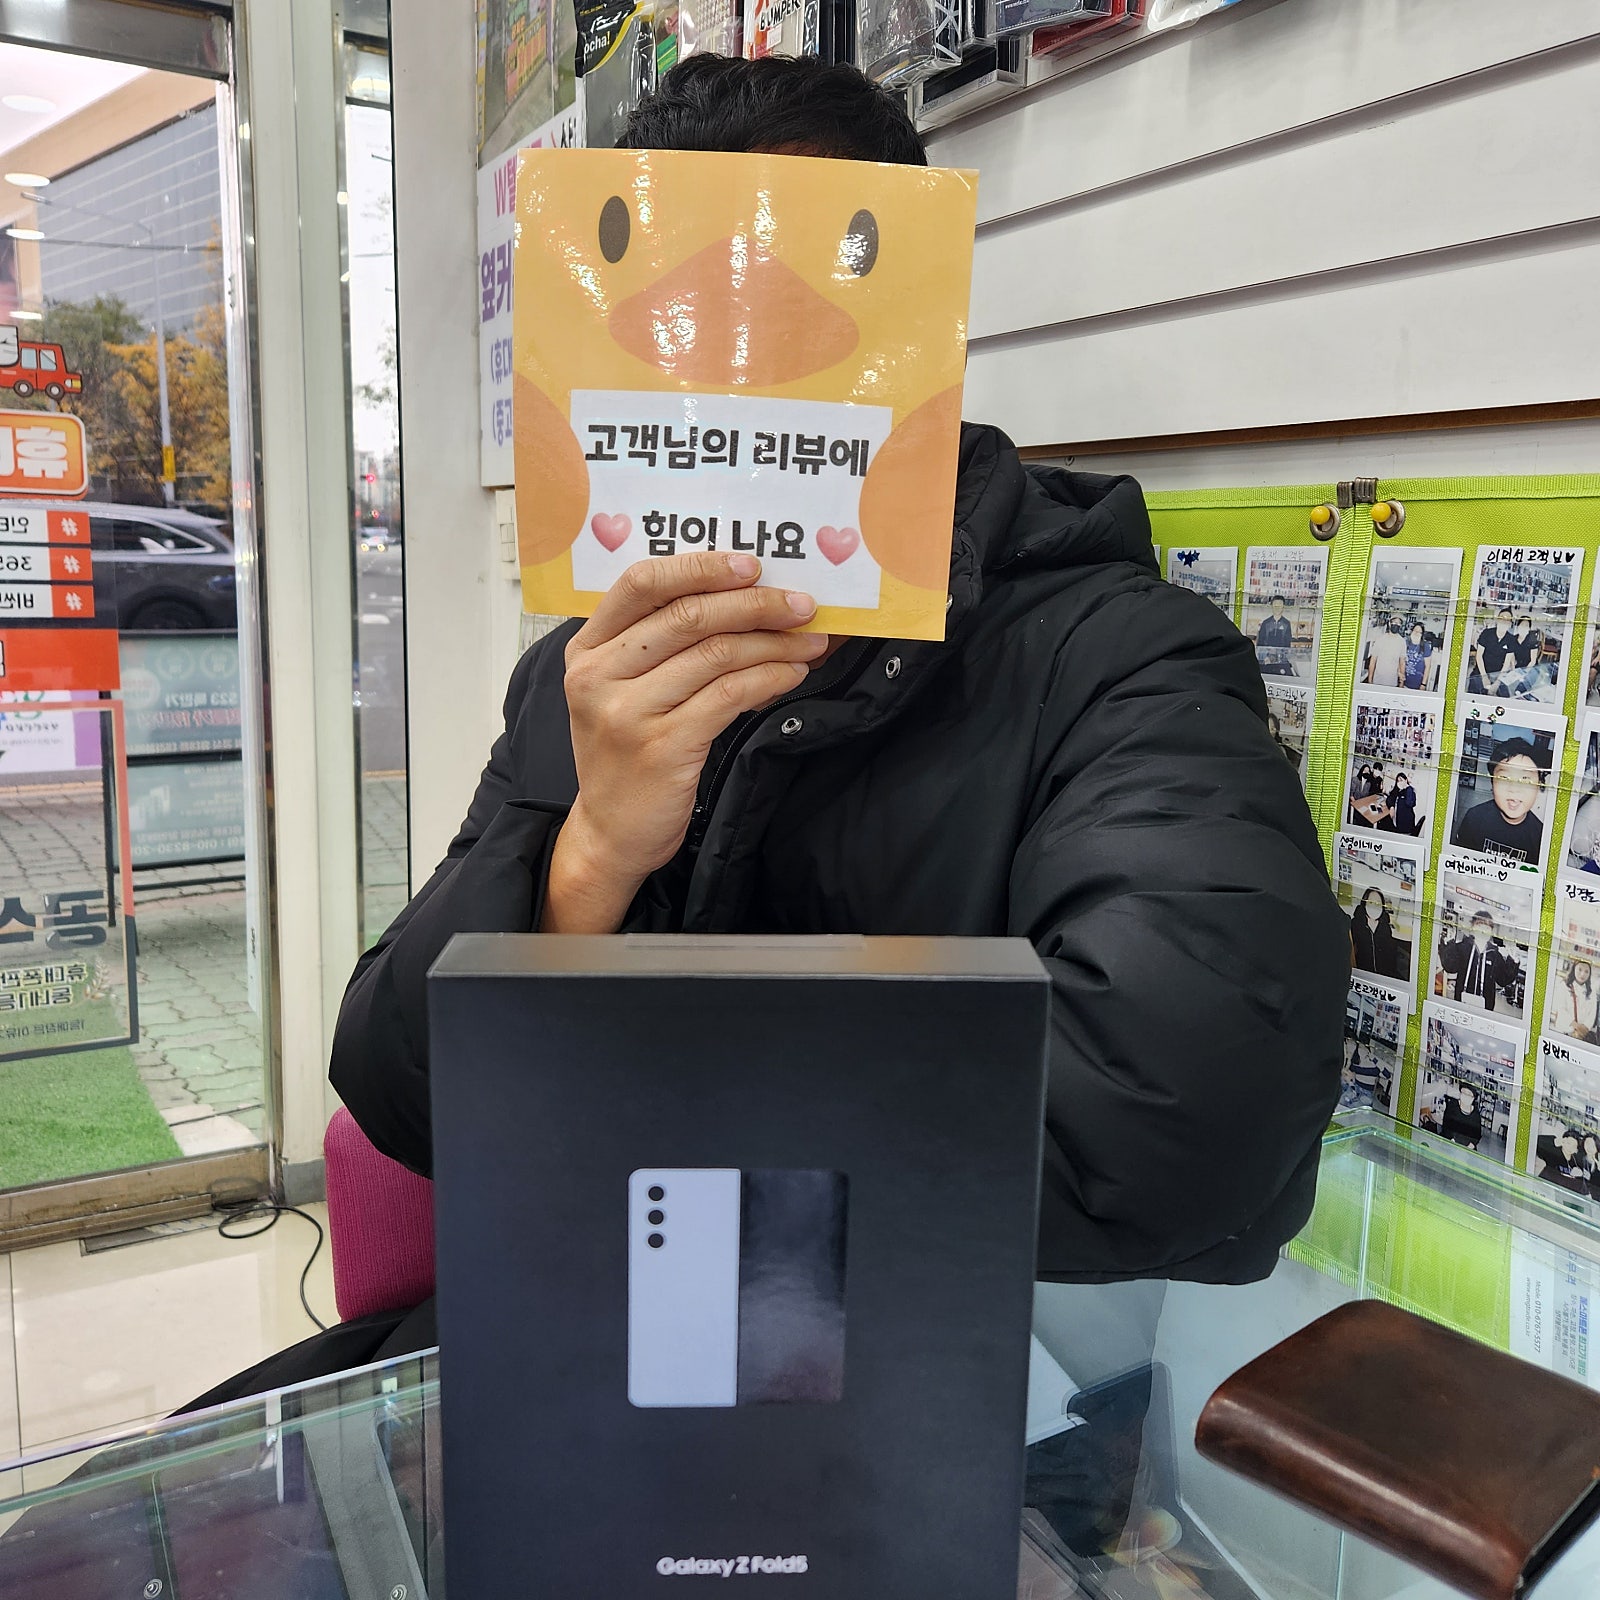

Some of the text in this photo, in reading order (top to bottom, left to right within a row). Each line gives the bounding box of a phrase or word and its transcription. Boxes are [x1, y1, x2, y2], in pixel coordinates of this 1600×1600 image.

[760, 0, 801, 31] BUMPER
[585, 424, 870, 477] 고객님의 리뷰에
[642, 509, 806, 560] 힘이 나요
[656, 1556, 735, 1578] Galaxy
[735, 1556, 750, 1574] Z
